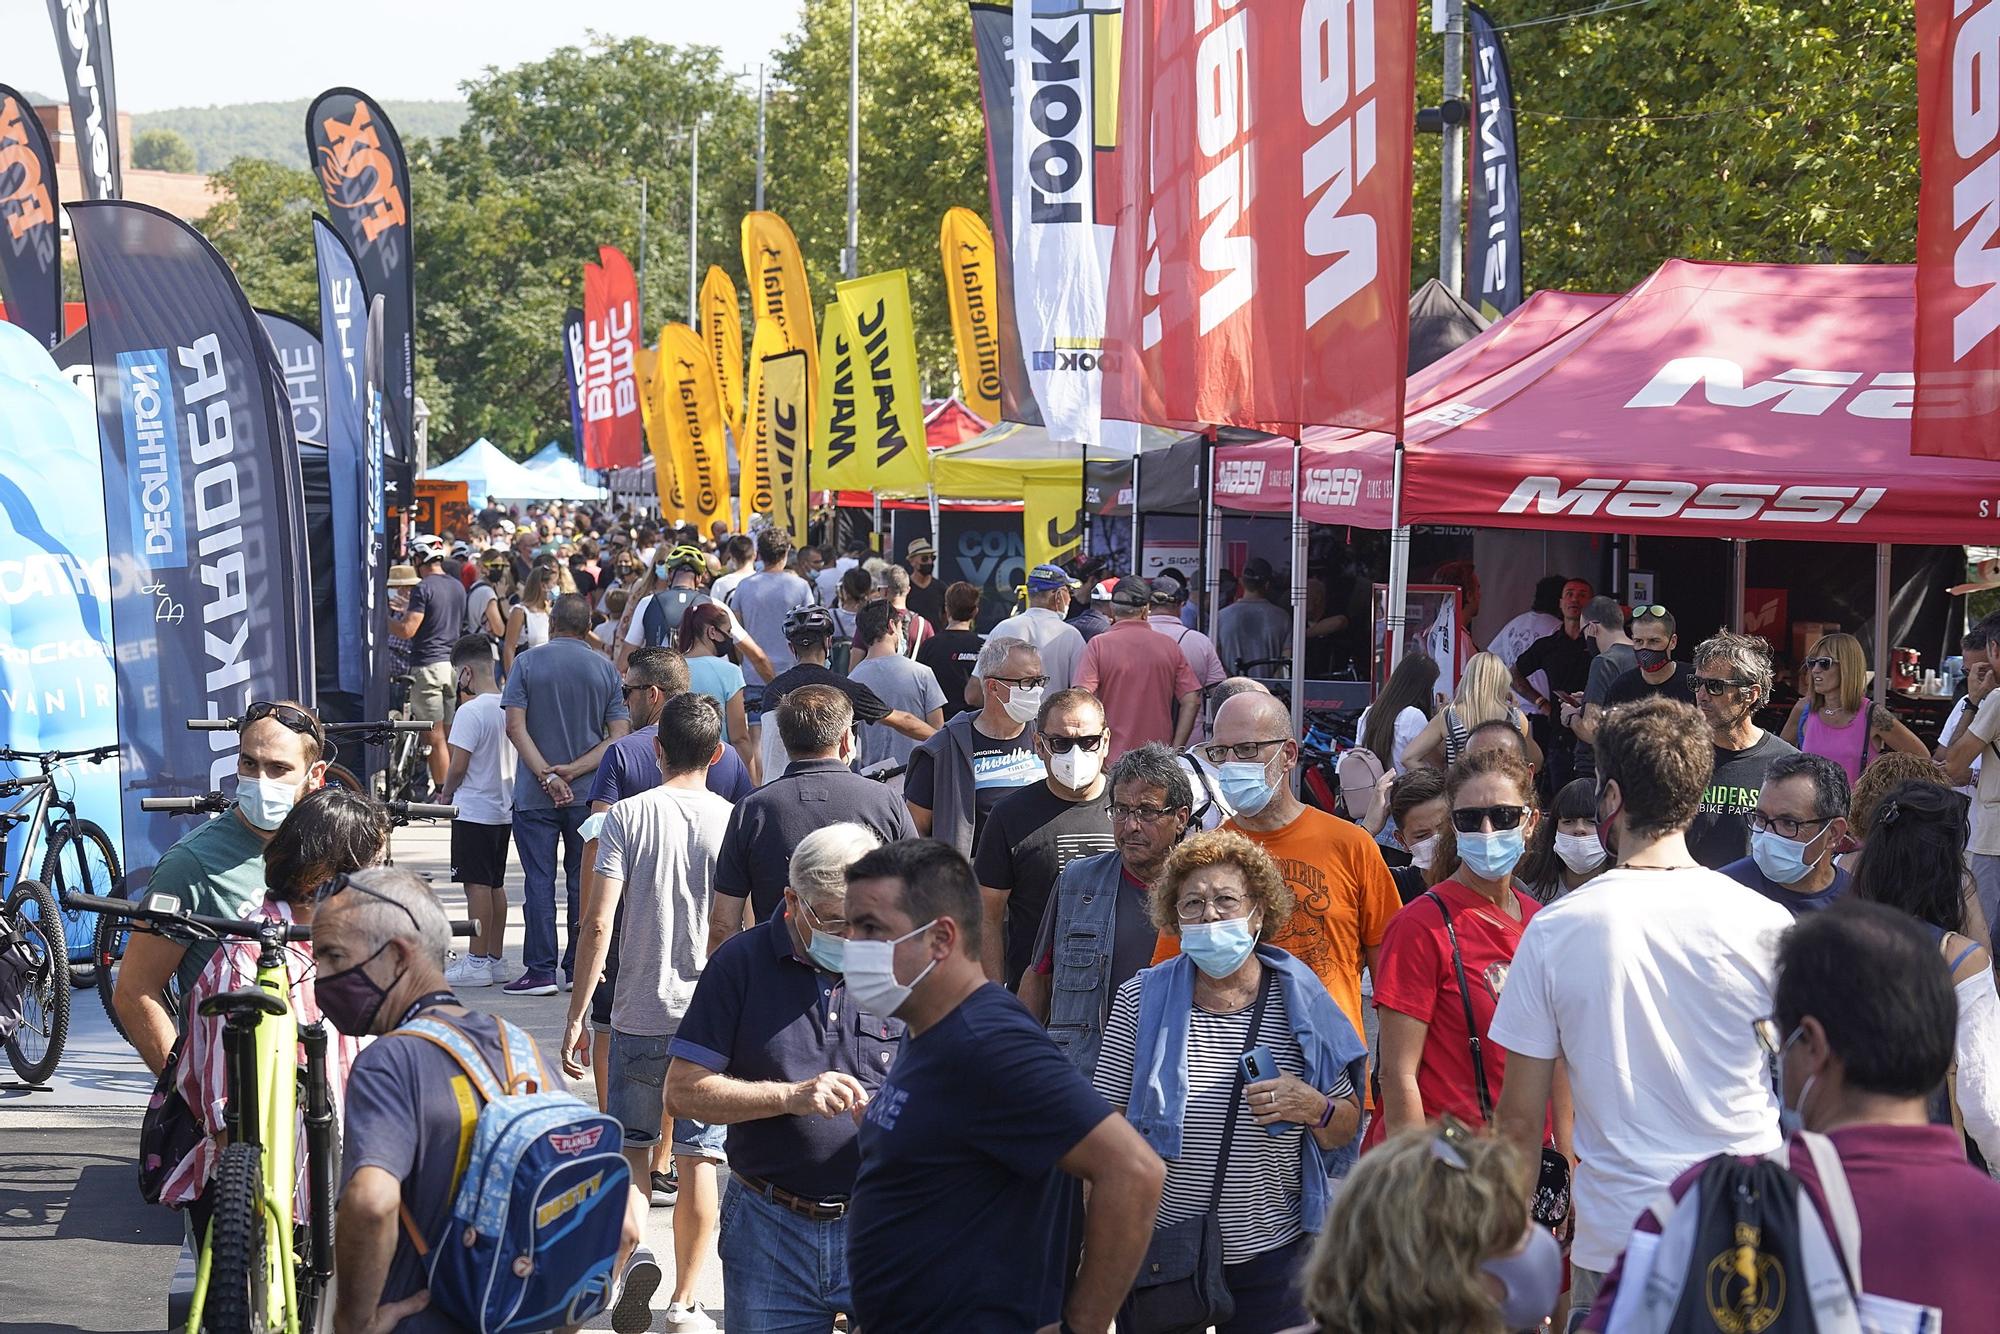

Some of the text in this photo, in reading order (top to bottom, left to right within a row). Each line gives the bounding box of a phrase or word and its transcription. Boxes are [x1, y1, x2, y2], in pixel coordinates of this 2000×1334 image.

[1302, 468, 1362, 507] MASSI
[1498, 476, 1886, 524] MASSI
[974, 747, 1033, 774] chwalbe
[1699, 803, 1724, 814] BIKE
[1702, 785, 1760, 808] RIDERS
